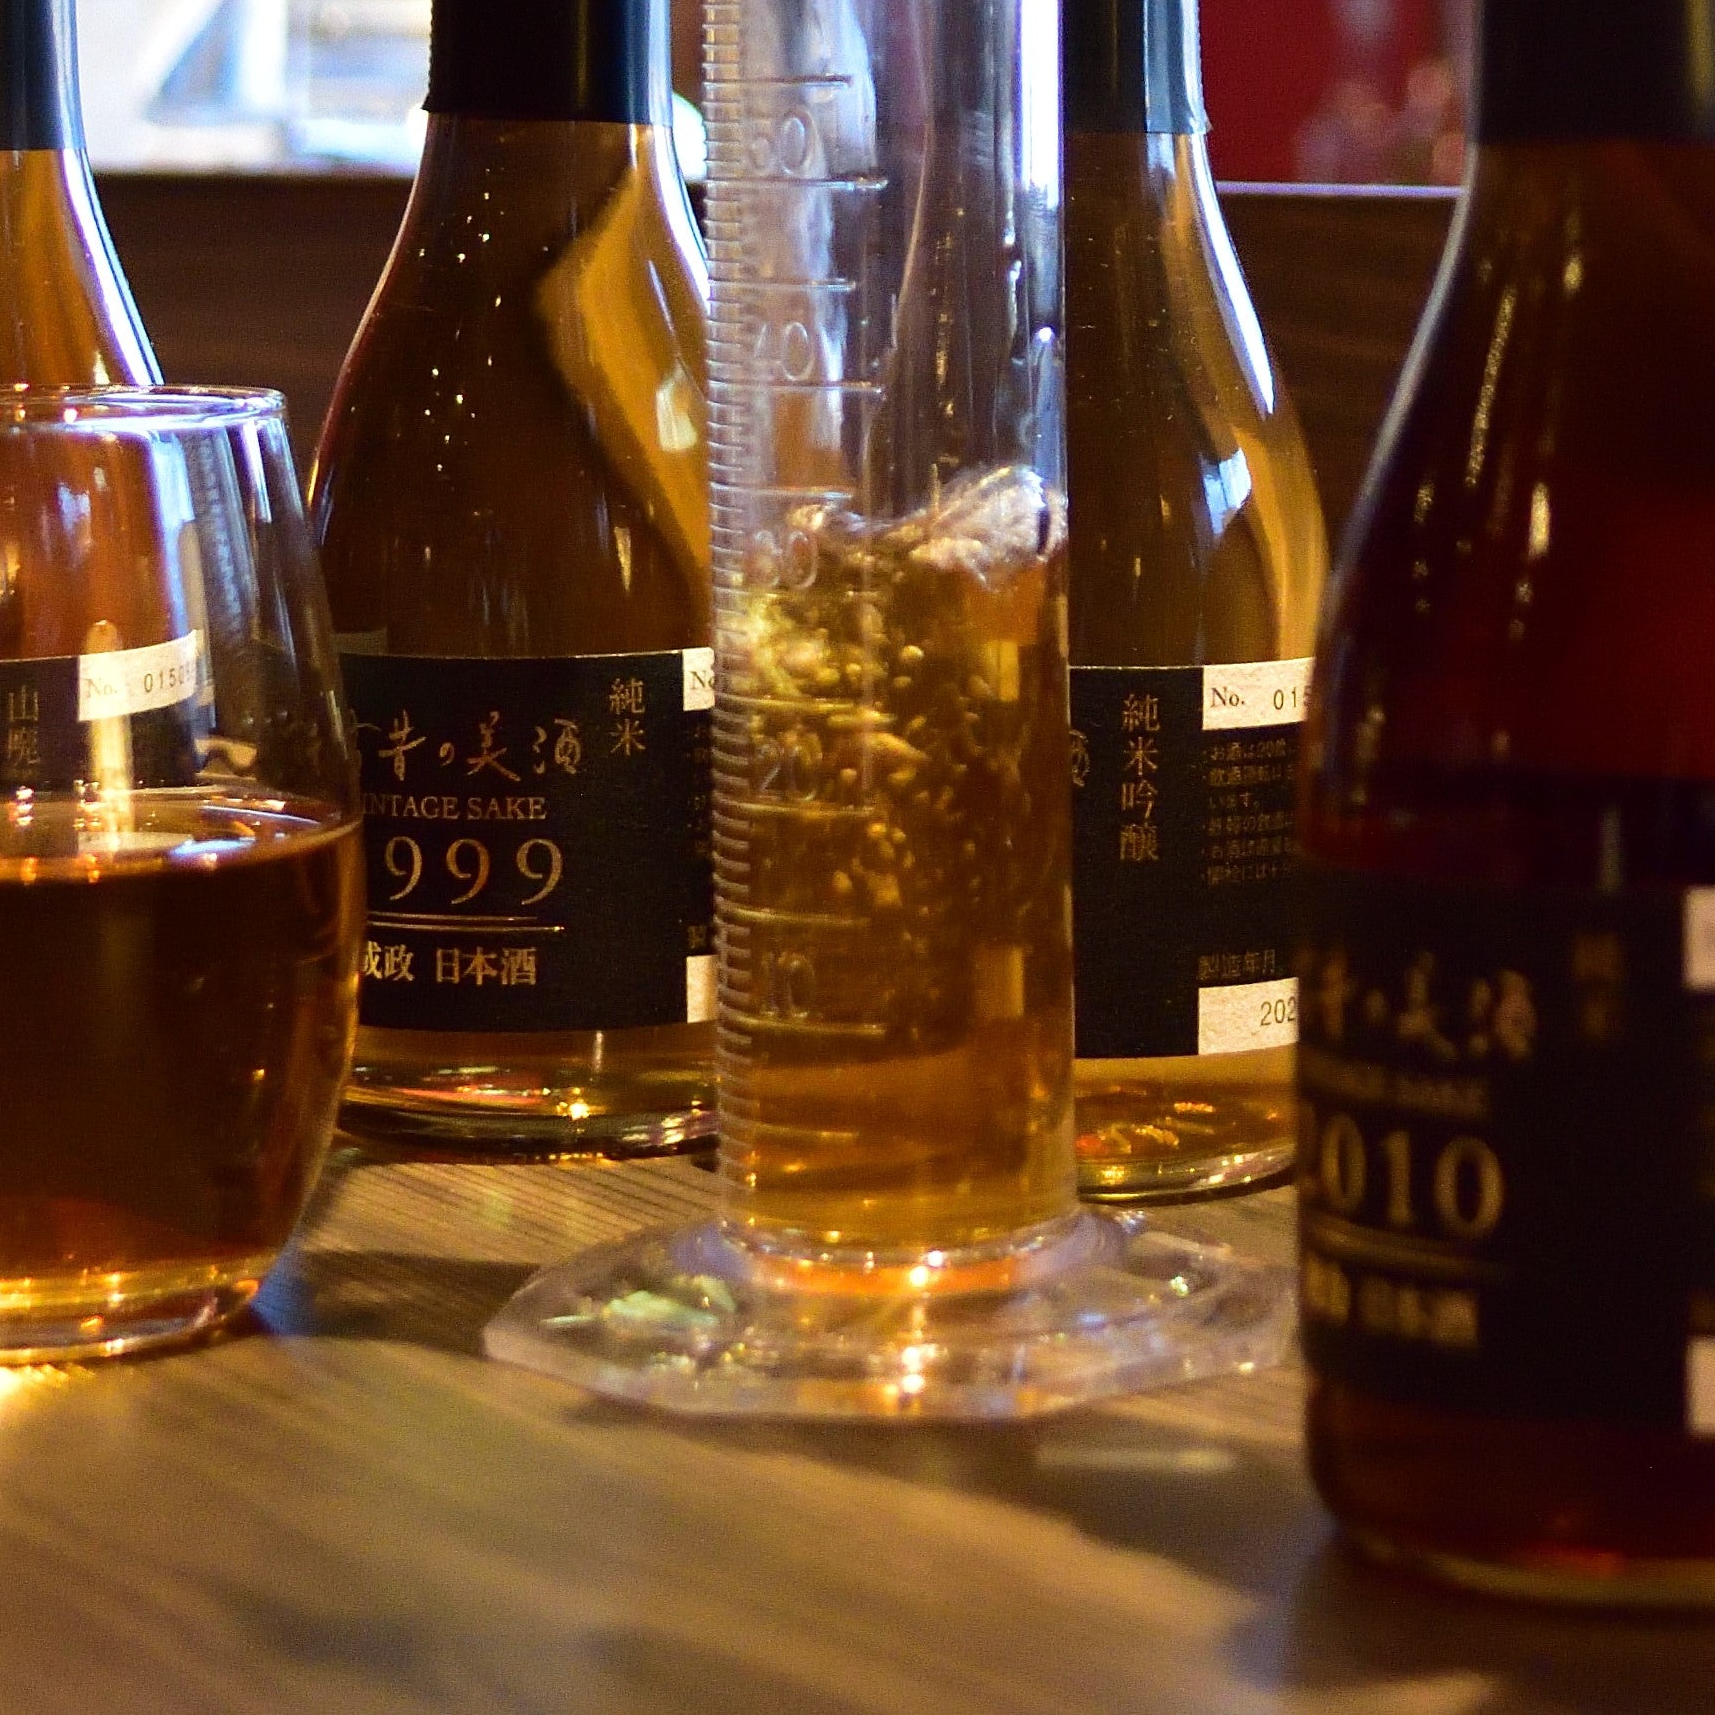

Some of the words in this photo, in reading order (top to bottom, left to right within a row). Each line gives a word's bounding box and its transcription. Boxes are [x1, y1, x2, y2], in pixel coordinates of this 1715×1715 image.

[608, 677, 647, 757] 純米
[1210, 687, 1246, 709] No.
[354, 709, 583, 783] 昔の美酒
[362, 794, 461, 820] INTAGE
[466, 796, 548, 821] SAKE
[385, 835, 564, 906] 999
[436, 946, 537, 986] 日本酒
[1300, 1106, 1506, 1241] 010
